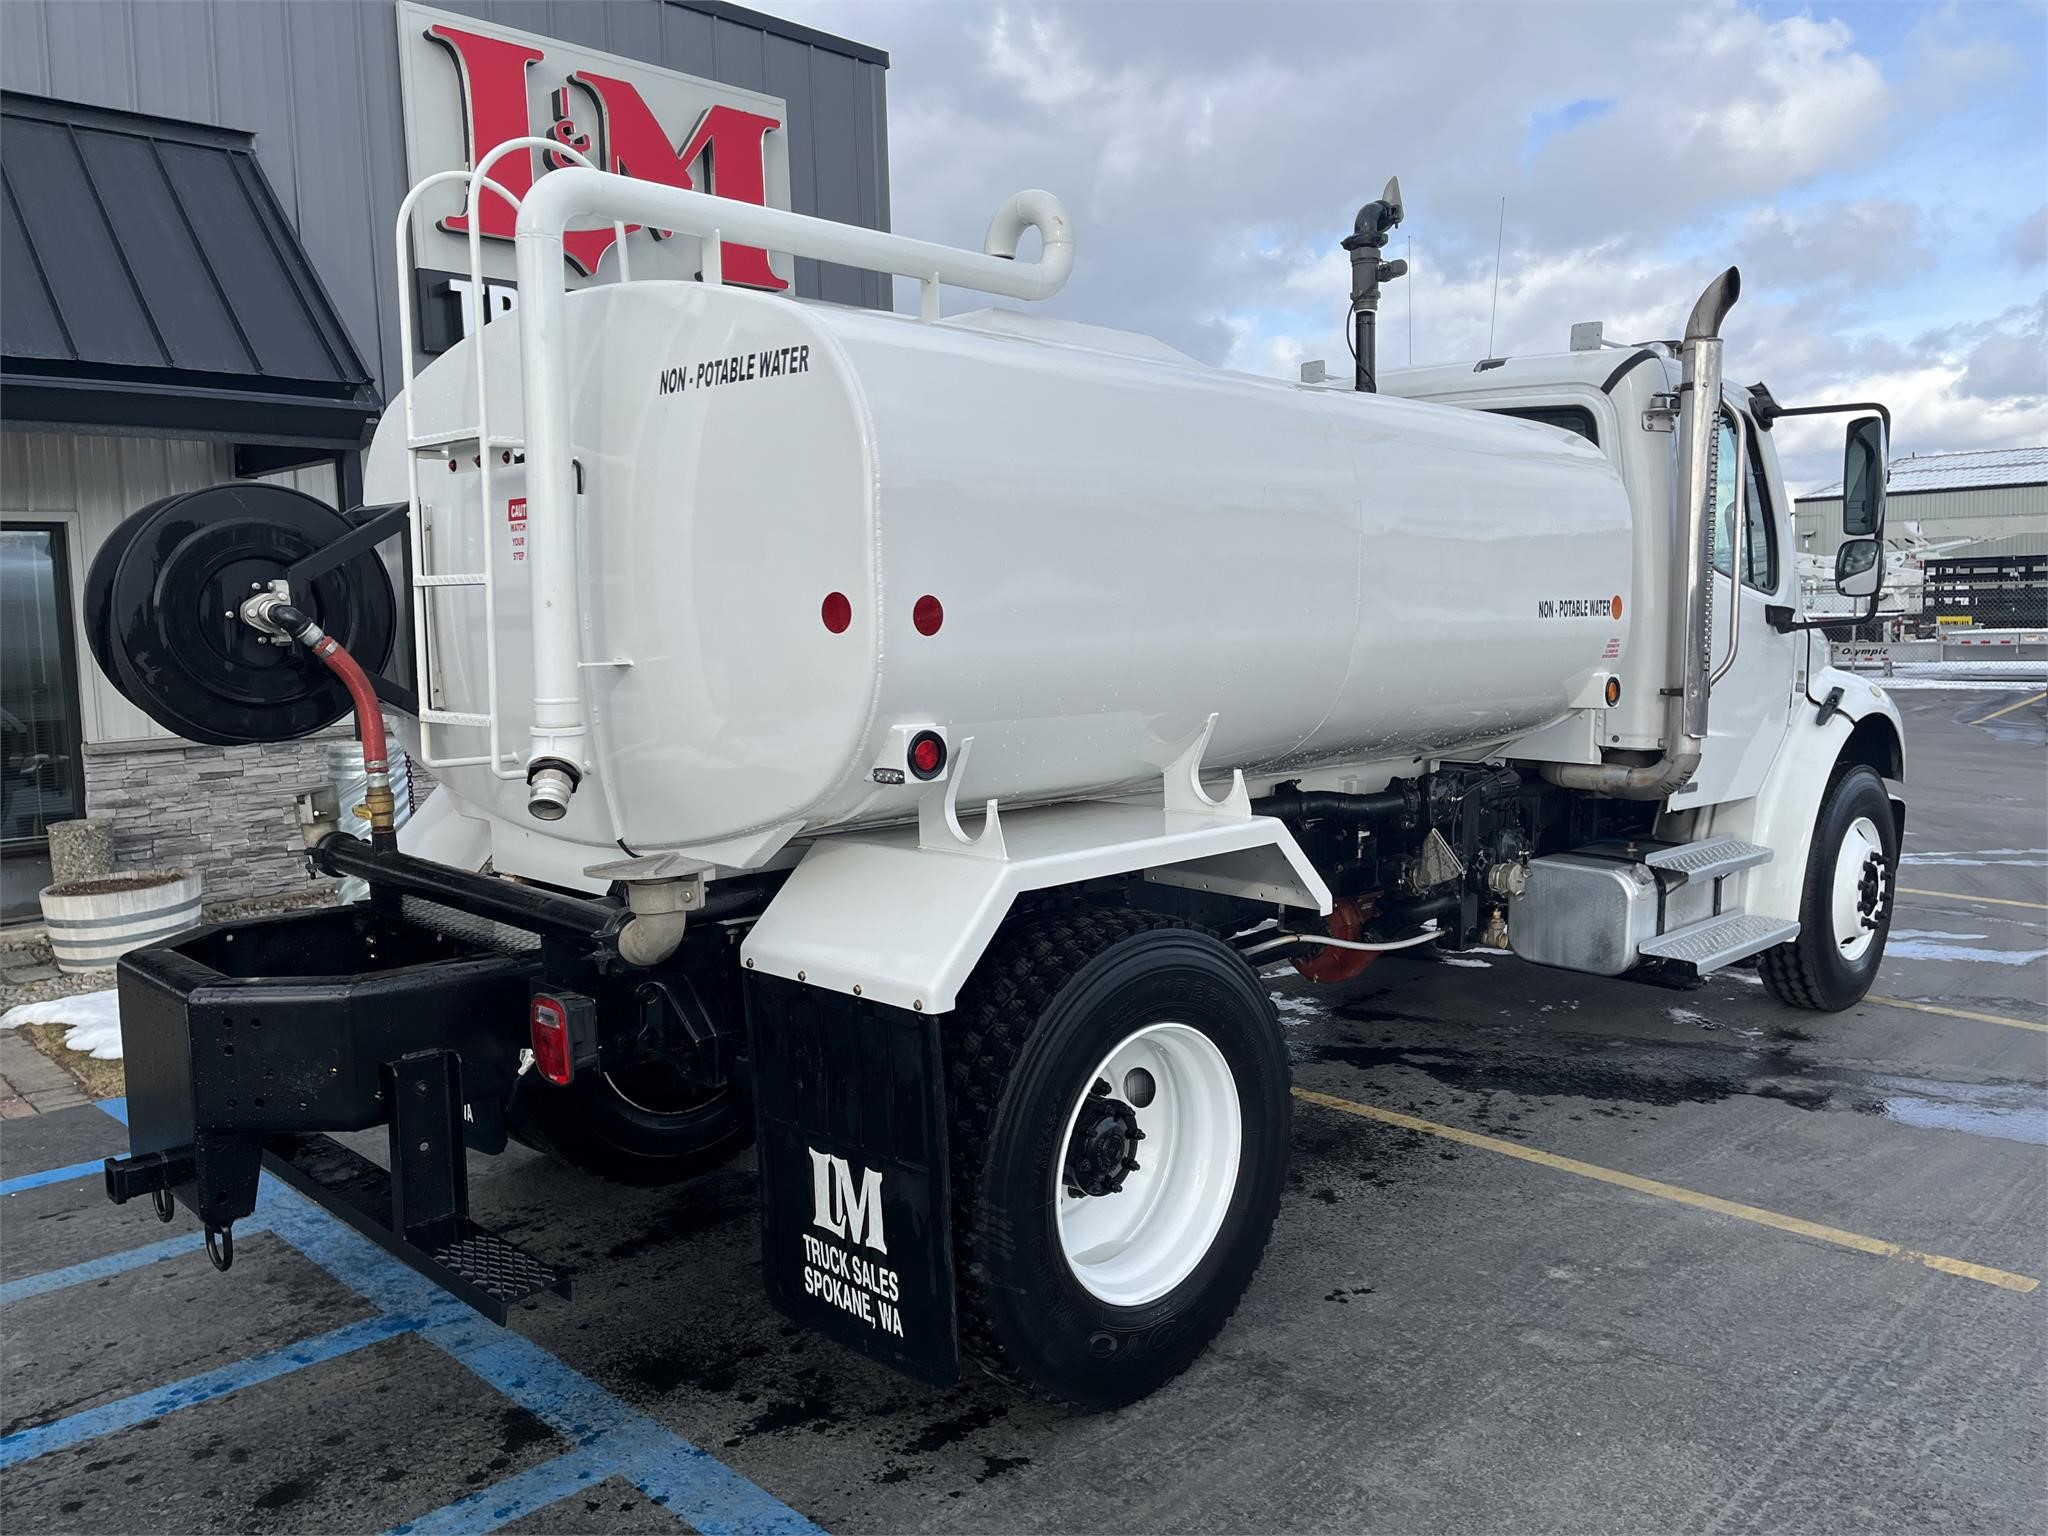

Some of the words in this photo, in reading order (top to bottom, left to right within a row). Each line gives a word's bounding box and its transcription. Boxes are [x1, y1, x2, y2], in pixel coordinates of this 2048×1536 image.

[660, 366, 687, 395] NON
[696, 353, 756, 389] POTABLE
[759, 345, 810, 379] WATER
[511, 504, 527, 517] CAUT
[512, 537, 525, 546] YOUR
[513, 552, 525, 560] STEP
[1539, 600, 1554, 618] NON
[1559, 600, 1588, 617] POTABLE
[1590, 599, 1611, 616] WATER
[1841, 647, 1888, 656] Oympic
[464, 1103, 474, 1123] A
[803, 1233, 850, 1280] TRUCK
[852, 1255, 899, 1302] SALES
[804, 1266, 876, 1329] SPOKANE,
[878, 1300, 904, 1338] WA
